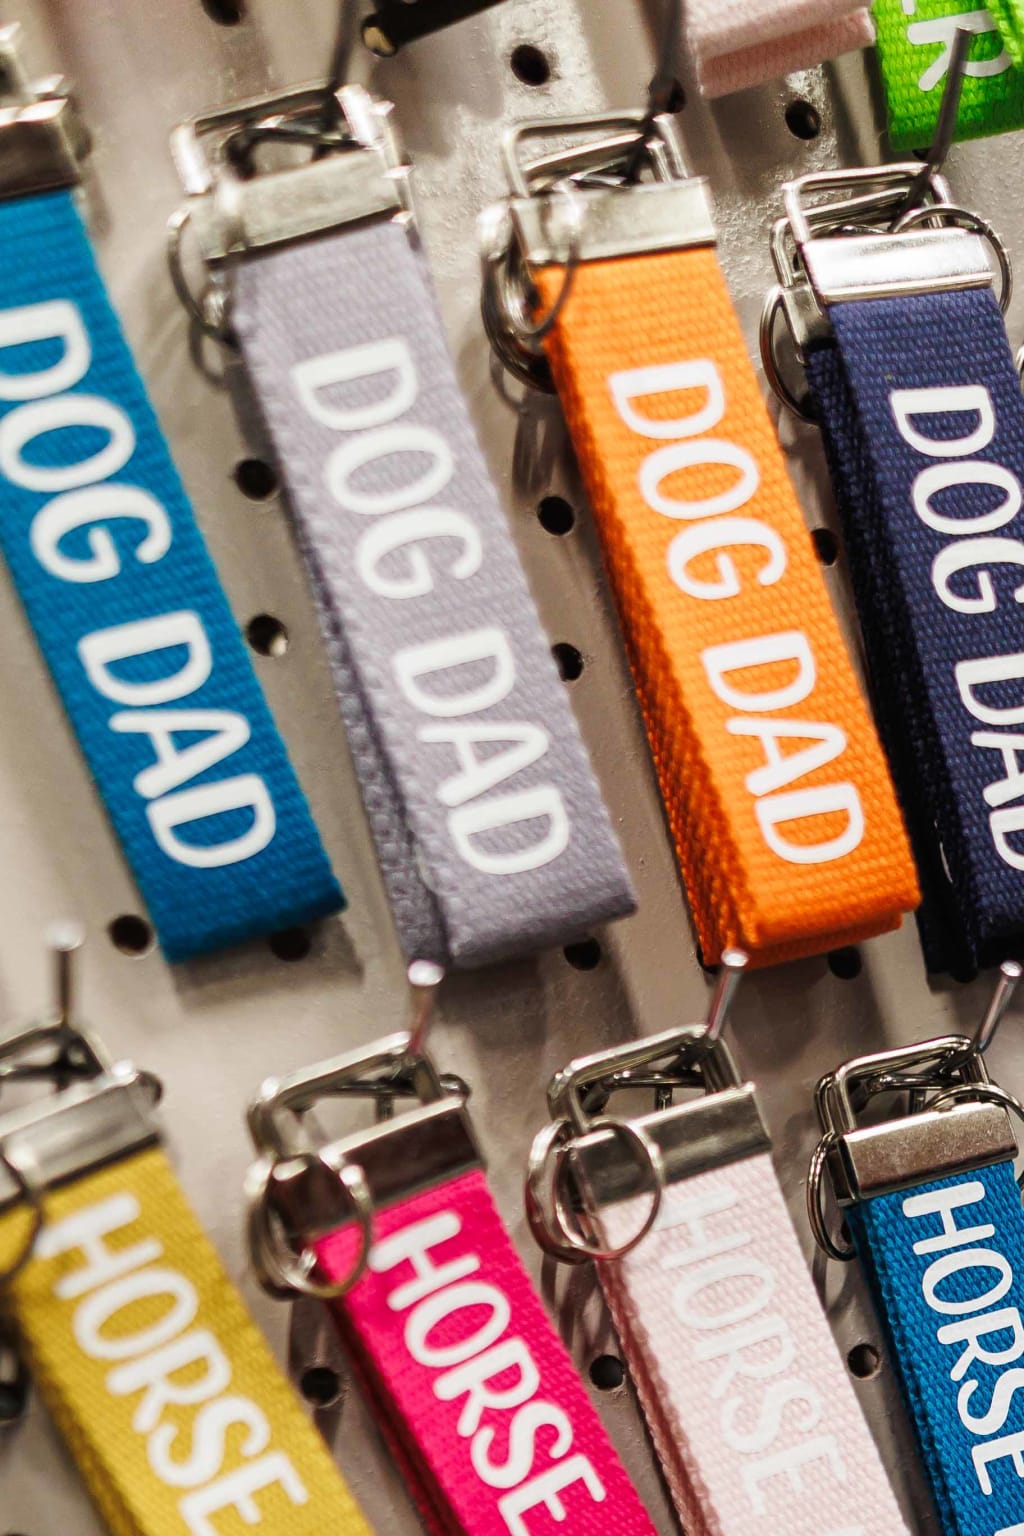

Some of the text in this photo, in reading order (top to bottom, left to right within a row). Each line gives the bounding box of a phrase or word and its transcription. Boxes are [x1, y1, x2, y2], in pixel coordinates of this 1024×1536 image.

[0, 299, 277, 869] DOG DAD
[292, 338, 570, 875] DOG DAD
[607, 361, 866, 865] DOG DAD
[650, 1181, 848, 1517] HORSE
